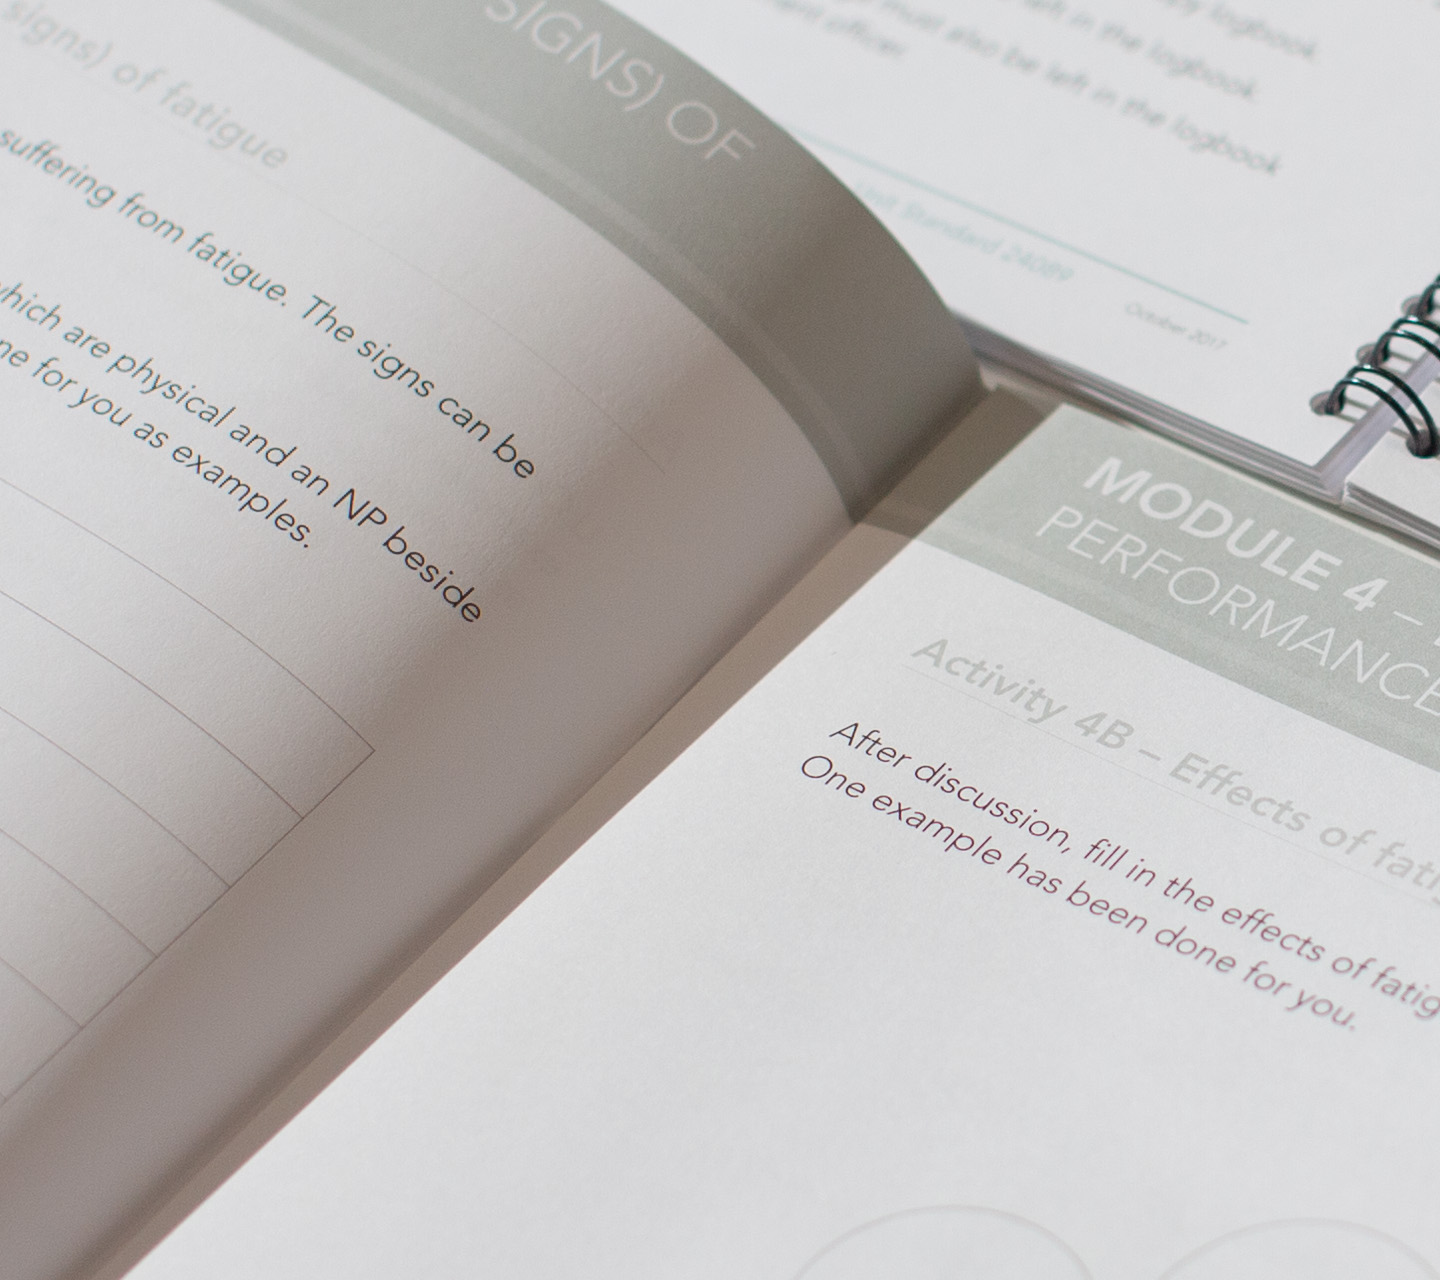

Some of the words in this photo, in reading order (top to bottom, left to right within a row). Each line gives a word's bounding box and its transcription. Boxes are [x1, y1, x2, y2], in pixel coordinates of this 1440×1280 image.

[1, 0, 115, 72] signs)
[111, 62, 169, 93] of
[159, 80, 288, 170] fatigue
[664, 99, 757, 161] OF
[117, 191, 186, 244] from
[186, 231, 292, 306] fatigue.
[301, 294, 356, 344] The
[355, 339, 436, 398] signs
[437, 397, 492, 443] can
[491, 433, 535, 479] be
[31, 356, 79, 393] for
[66, 387, 133, 427] you
[132, 422, 170, 449] as
[171, 445, 311, 547] examples.
[62, 325, 112, 359] are
[105, 353, 237, 428] physical
[228, 424, 299, 468] and
[289, 464, 330, 497] an
[332, 487, 389, 527] NP
[381, 525, 482, 623] beside
[1082, 456, 1343, 592] MODULE
[1342, 577, 1390, 612] 4
[828, 721, 912, 768] After
[912, 761, 1071, 855] discussion,
[1083, 837, 1130, 871] fill
[1124, 857, 1158, 888] in
[1161, 877, 1216, 913] the
[1220, 907, 1327, 963] effects
[1329, 955, 1377, 980] of
[910, 638, 1069, 726] Activity
[1073, 711, 1136, 750] 4B
[1168, 751, 1311, 833] Effects
[1318, 826, 1378, 856] of
[799, 754, 867, 799] One
[870, 794, 1003, 866] example
[1005, 852, 1064, 895] has
[1064, 879, 1149, 935] been
[1153, 925, 1238, 975] done
[1241, 959, 1292, 996] for
[1284, 989, 1356, 1031] you.
